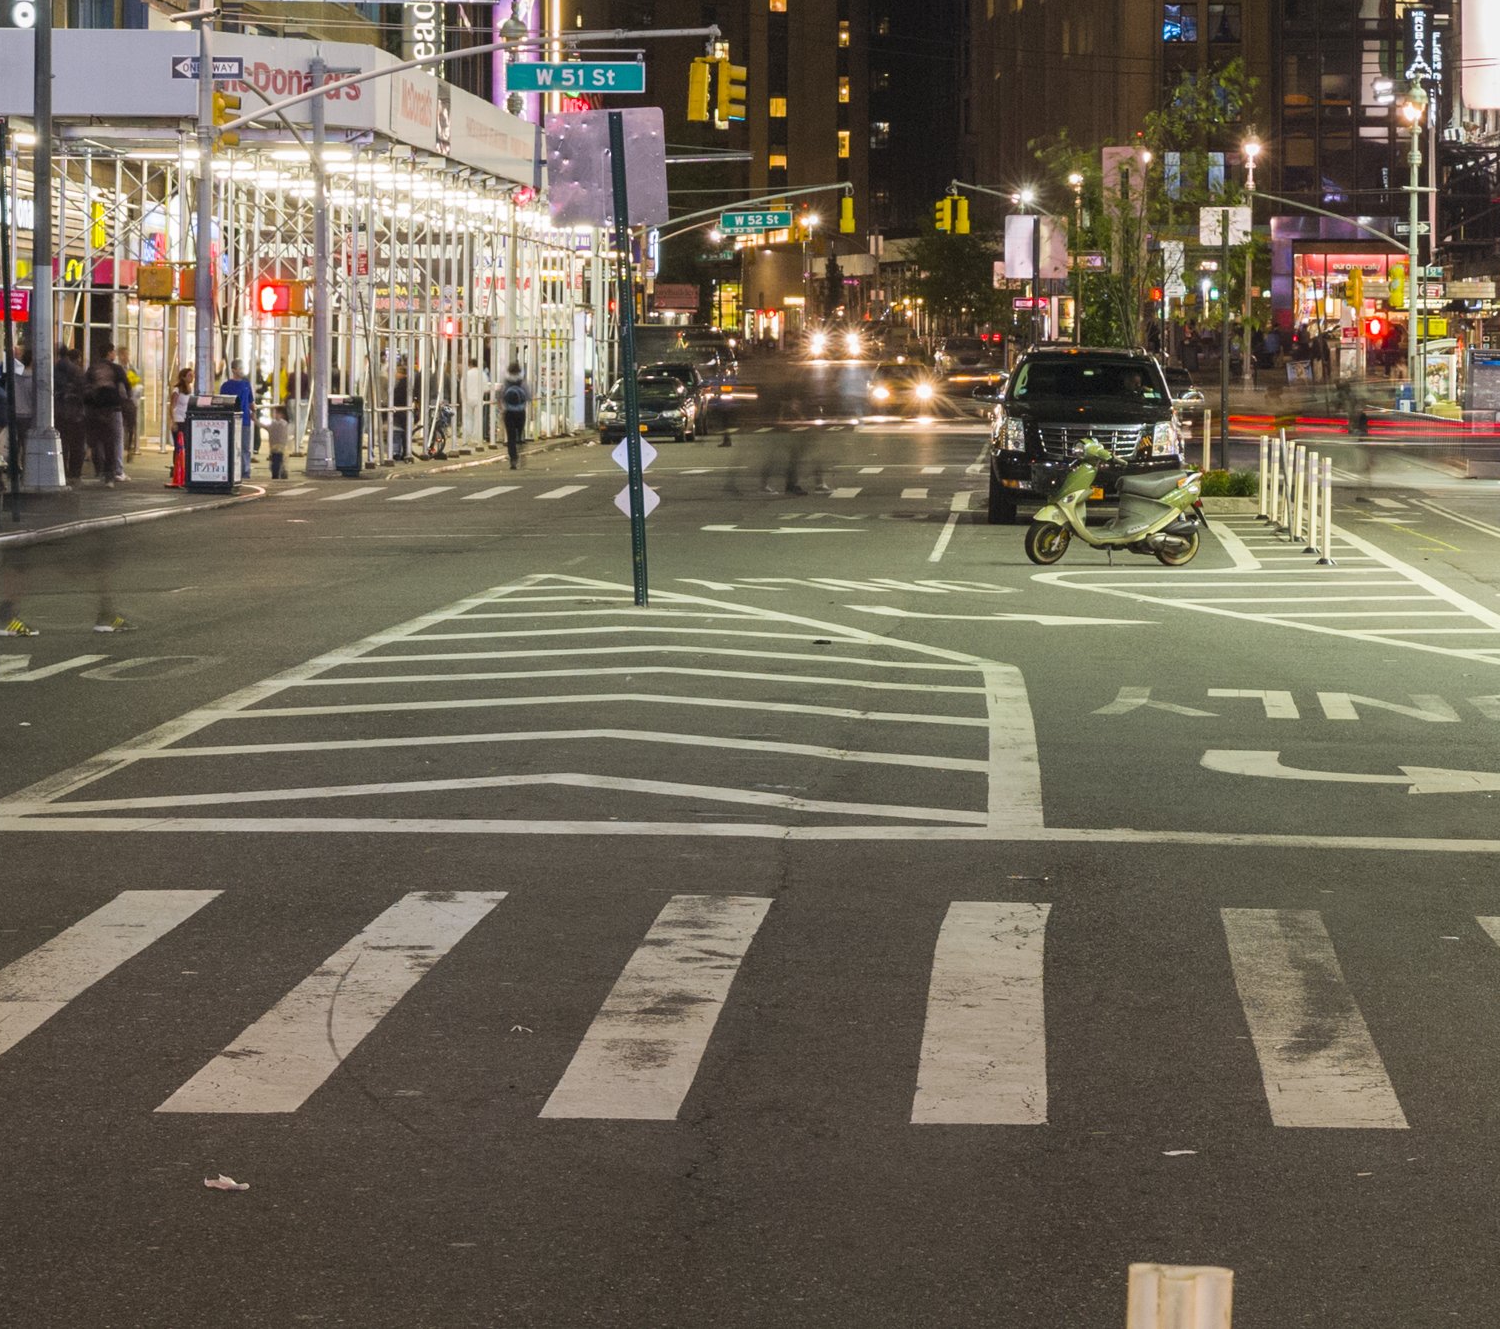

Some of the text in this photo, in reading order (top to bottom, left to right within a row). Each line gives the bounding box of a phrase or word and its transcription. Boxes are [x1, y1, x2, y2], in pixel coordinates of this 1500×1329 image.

[1414, 16, 1424, 63] ROBATA
[536, 69, 616, 86] W 51 St
[734, 214, 779, 225] W 52 St
